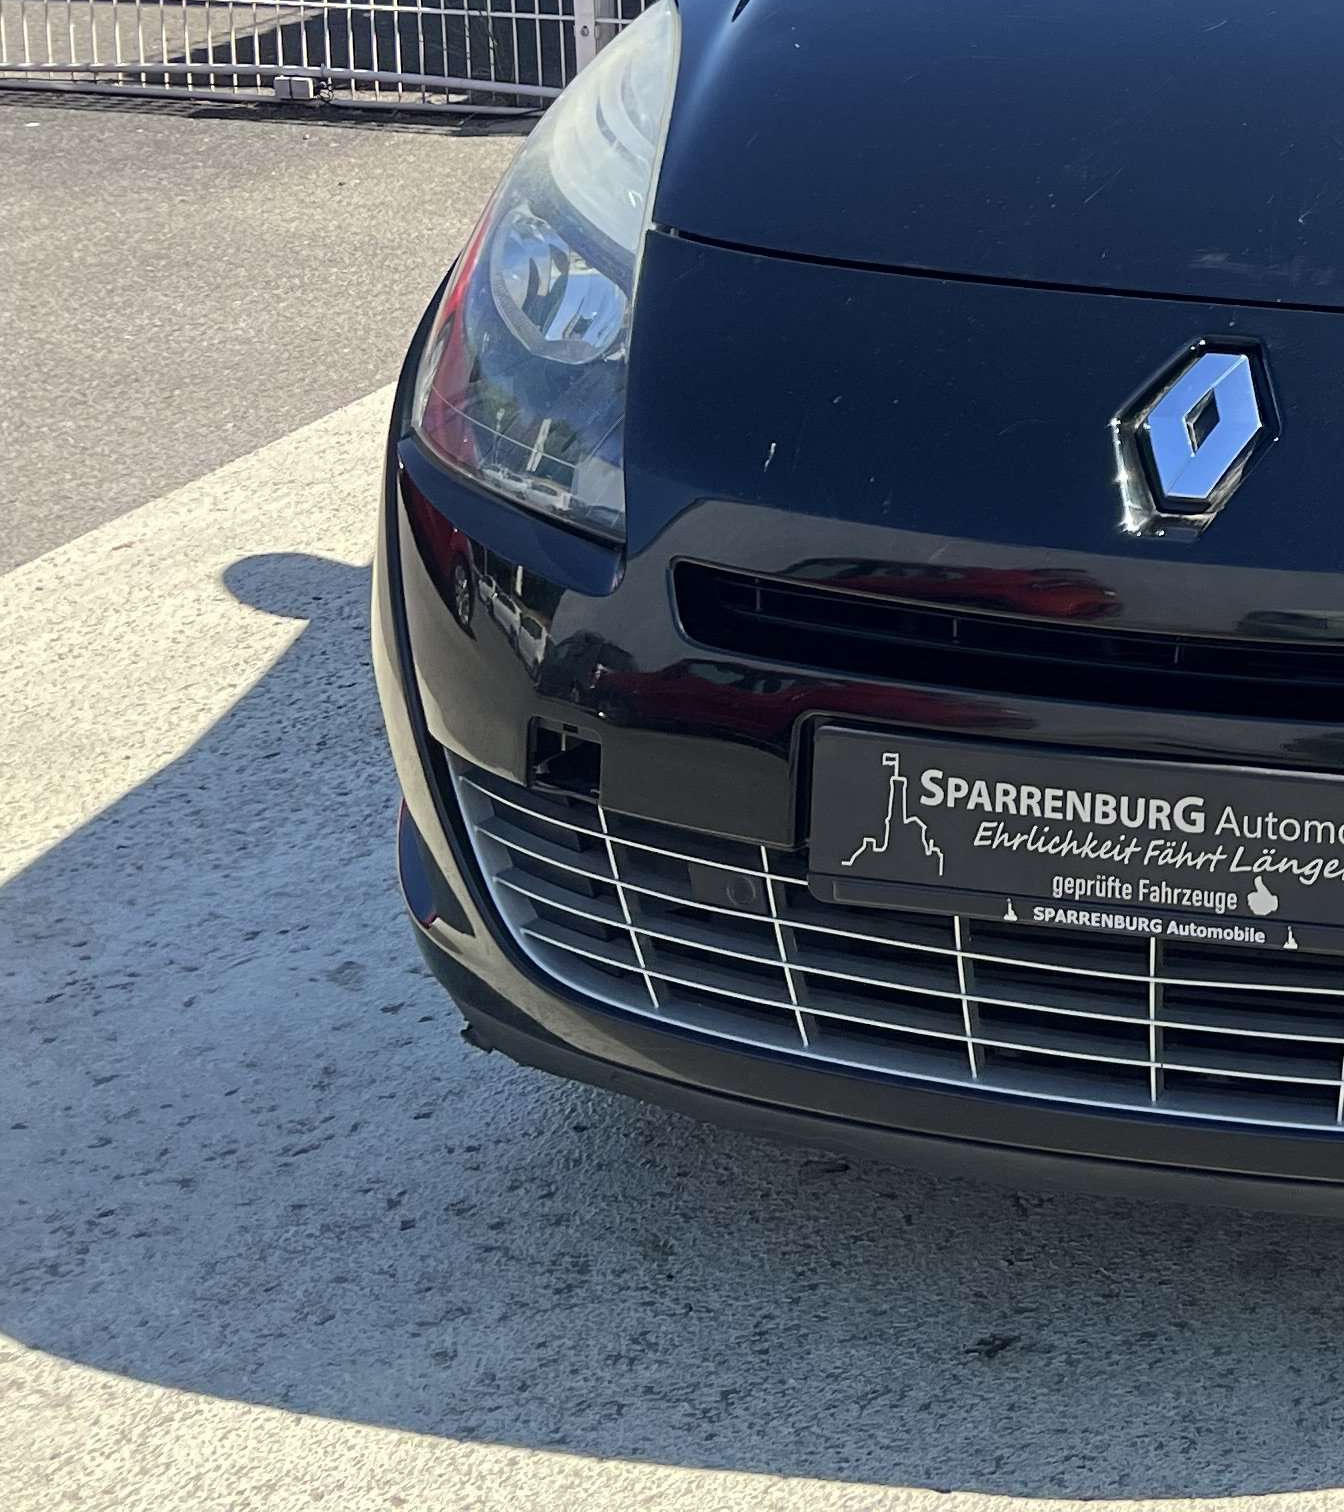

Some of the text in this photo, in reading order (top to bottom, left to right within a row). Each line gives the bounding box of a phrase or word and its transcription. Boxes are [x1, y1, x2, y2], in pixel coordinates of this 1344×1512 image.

[918, 768, 1206, 835] SPARRENBURG
[973, 821, 1143, 865] Ehrlichkeit
[1143, 838, 1229, 875] Fährt
[1051, 873, 1238, 914] geprüfte Fahrzeuge
[1033, 906, 1267, 944] SPARRENBURG Automobile
